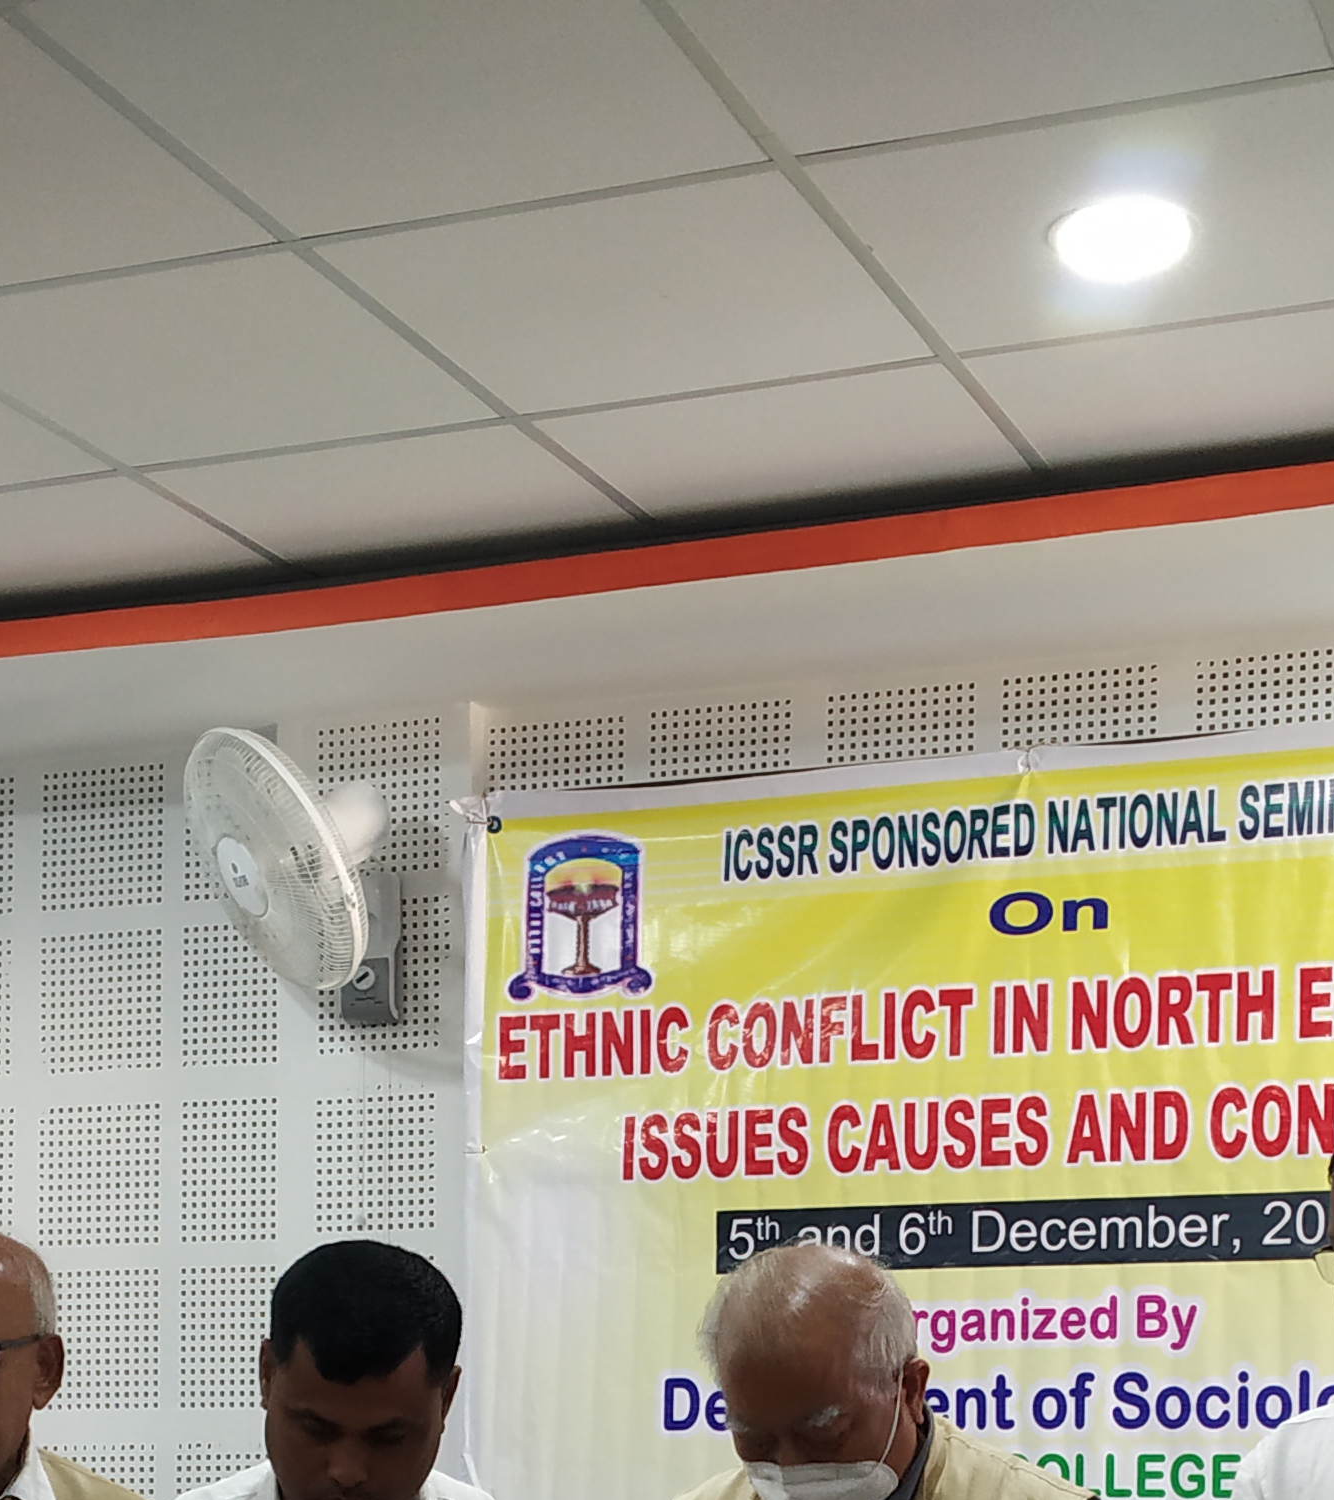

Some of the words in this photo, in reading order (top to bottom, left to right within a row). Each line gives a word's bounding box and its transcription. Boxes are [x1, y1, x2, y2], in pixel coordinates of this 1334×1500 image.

[723, 824, 820, 883] ICSSR
[828, 803, 1036, 875] SPONSORED
[1047, 788, 1227, 855] NATIONAL
[990, 892, 1109, 936] On
[497, 1007, 690, 1080] ETHNIC
[707, 988, 974, 1072] CONFLICT
[994, 983, 1049, 1055] IN
[1071, 970, 1275, 1050] NORTH
[623, 1107, 810, 1181] ISSUES
[827, 1096, 1049, 1174] CAUSES
[1067, 1091, 1189, 1165] AND
[899, 1209, 953, 1256] 6th
[971, 1195, 1241, 1255] December,
[912, 1295, 1118, 1354] rganized
[1136, 1294, 1198, 1351] By
[1032, 1371, 1096, 1430] of
[1014, 1453, 1242, 1499] OLLEGE
